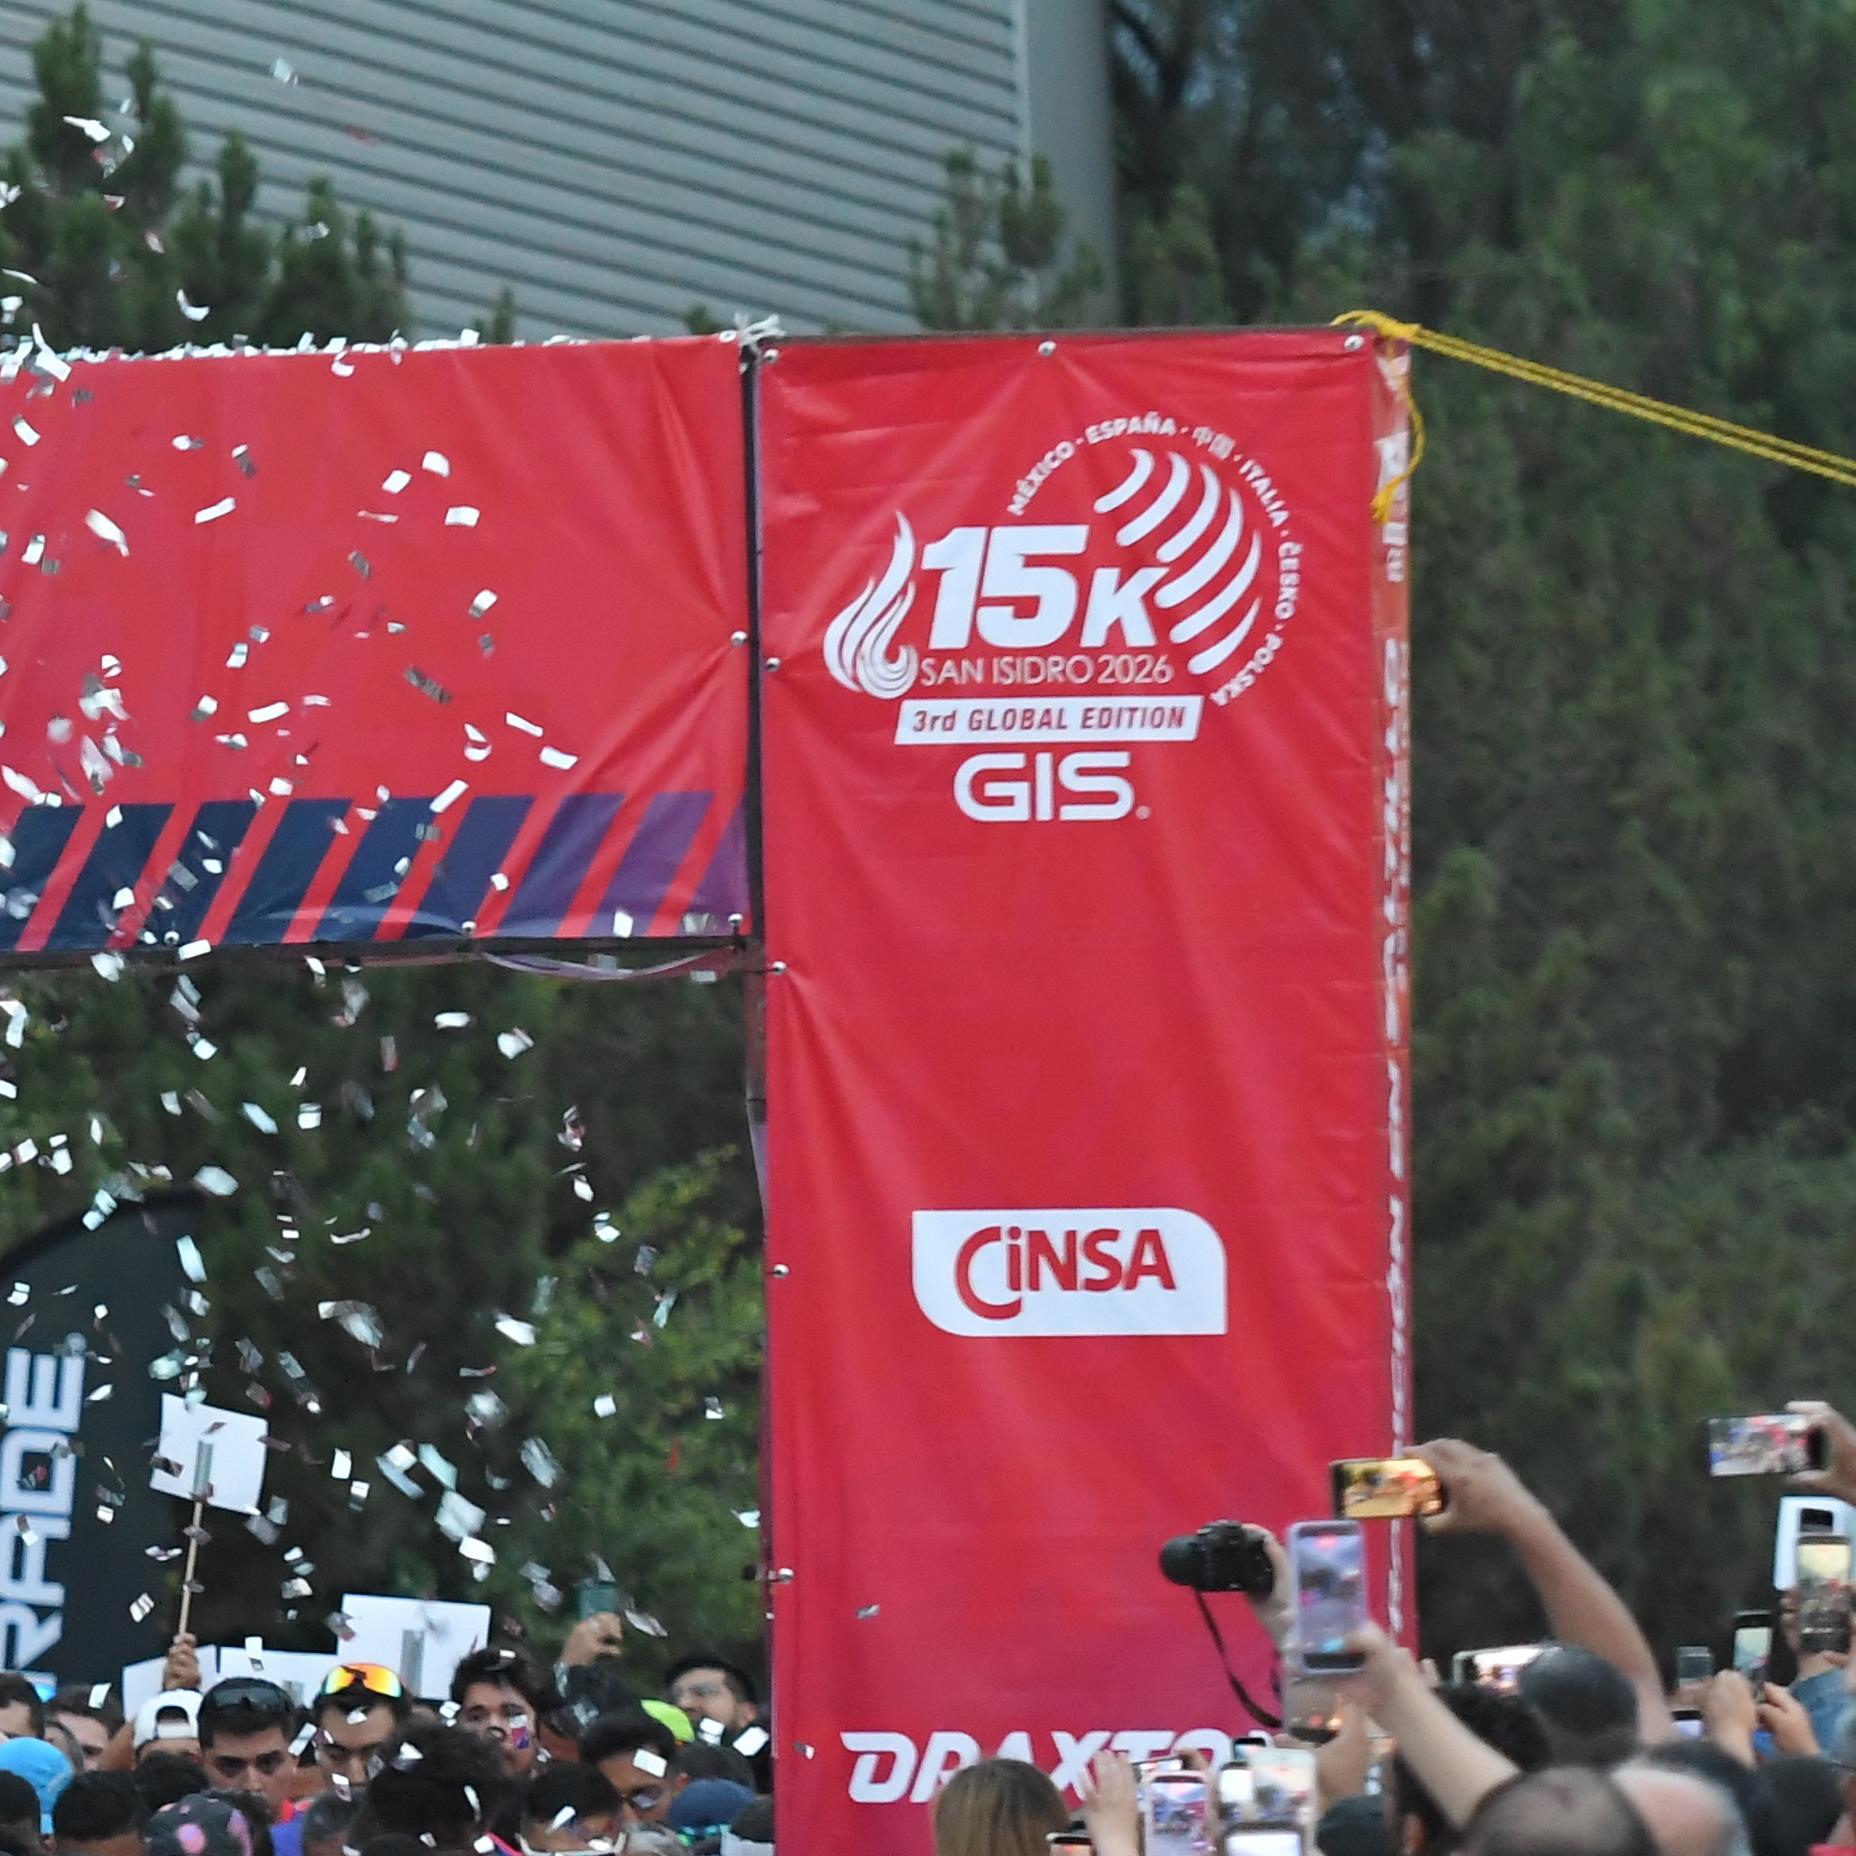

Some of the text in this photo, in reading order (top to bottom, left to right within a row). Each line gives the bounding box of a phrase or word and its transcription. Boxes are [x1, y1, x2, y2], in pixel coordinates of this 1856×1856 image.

[1085, 411, 1177, 446] ESPAÑA
[1008, 440, 1073, 516] MÉXICO
[1239, 457, 1288, 529] ITALIA
[920, 525, 1170, 649] 15K
[921, 654, 1173, 686] SAN ISIDRO 2026
[1209, 632, 1284, 707] POLSKA
[913, 706, 1185, 732] 3rd GLOBAL EDITION
[953, 751, 1134, 821] GIS
